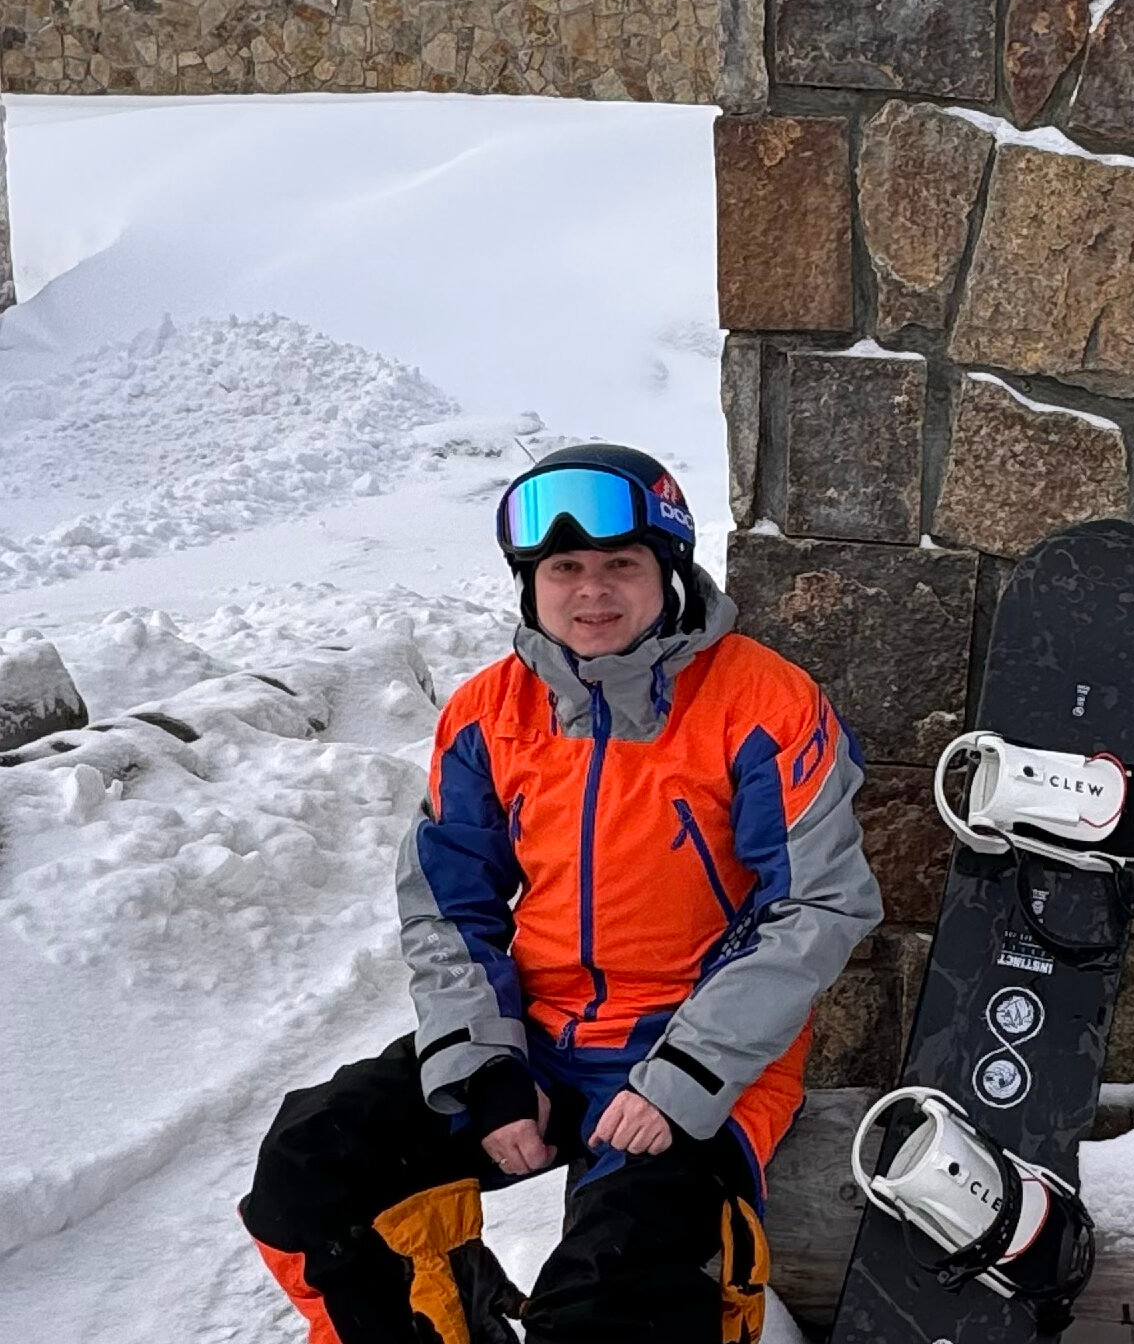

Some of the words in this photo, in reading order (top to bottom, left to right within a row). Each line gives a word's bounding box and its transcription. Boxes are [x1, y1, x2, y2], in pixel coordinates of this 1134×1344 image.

[1049, 775, 1104, 797] CLEW
[997, 954, 1054, 975] INSTINCT
[970, 1180, 1003, 1212] CLE
